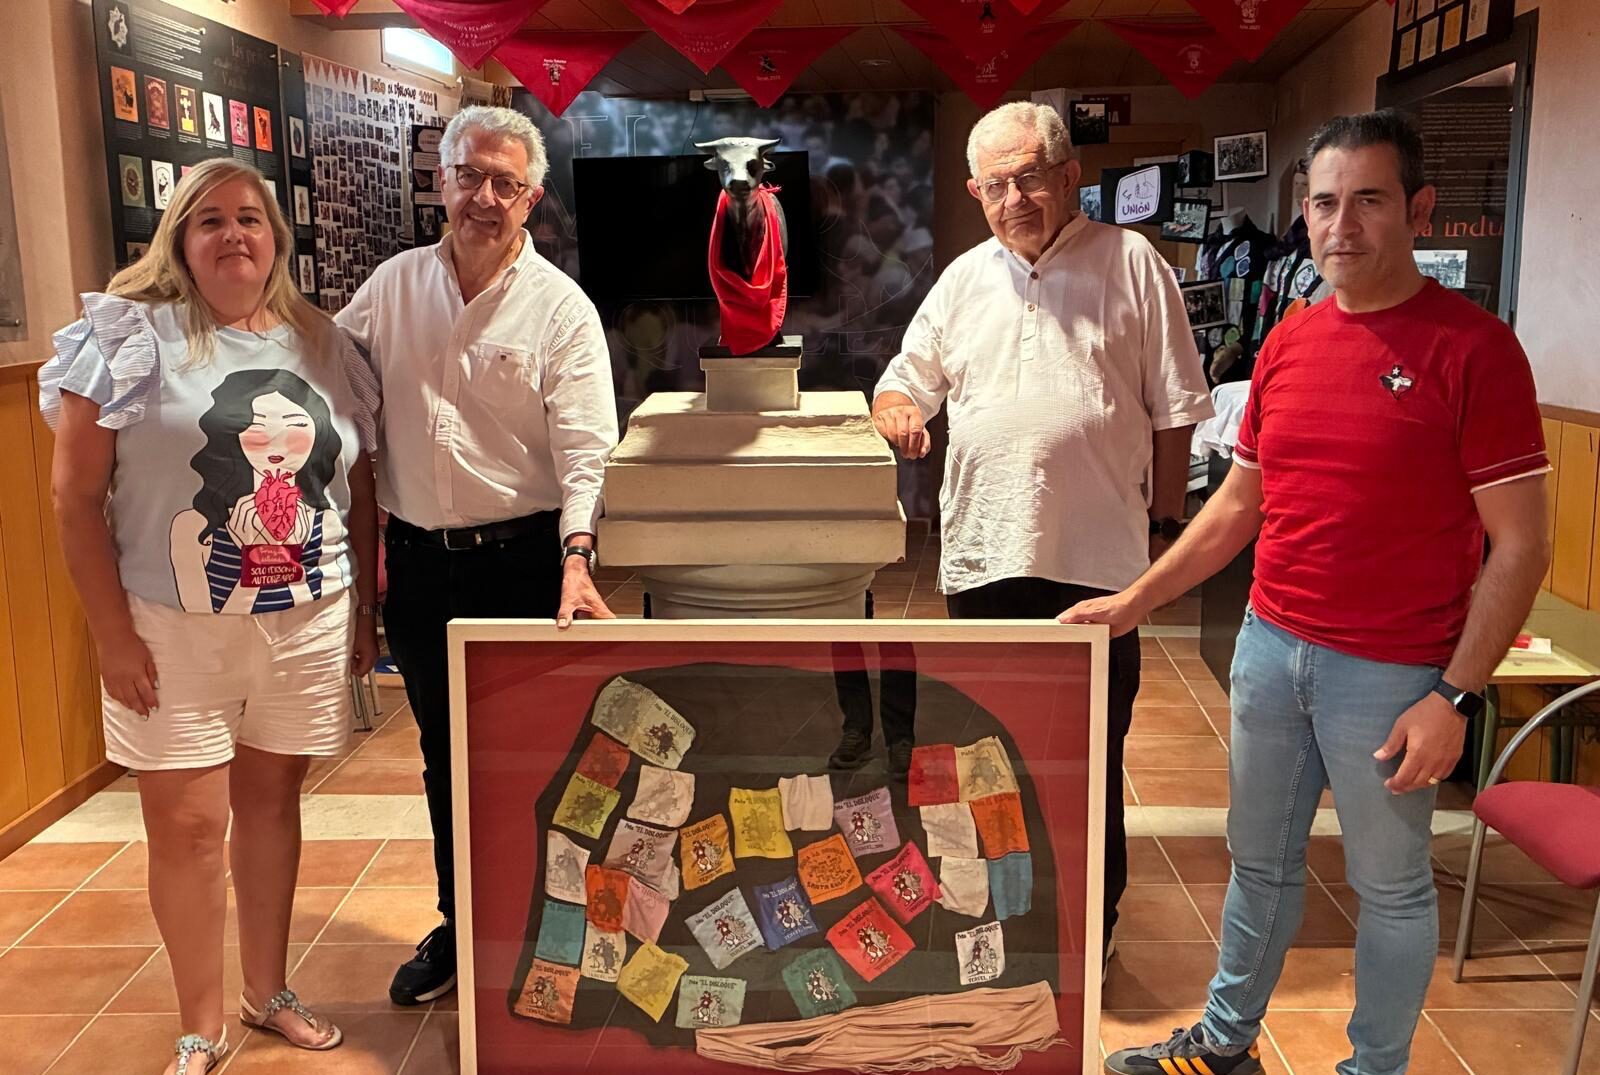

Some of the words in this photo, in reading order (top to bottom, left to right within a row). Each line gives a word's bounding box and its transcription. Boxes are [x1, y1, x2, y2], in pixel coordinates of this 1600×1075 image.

[1122, 202, 1150, 216] UNIÓN
[251, 567, 267, 576] SOLO
[251, 574, 295, 585] AUTORIZADO
